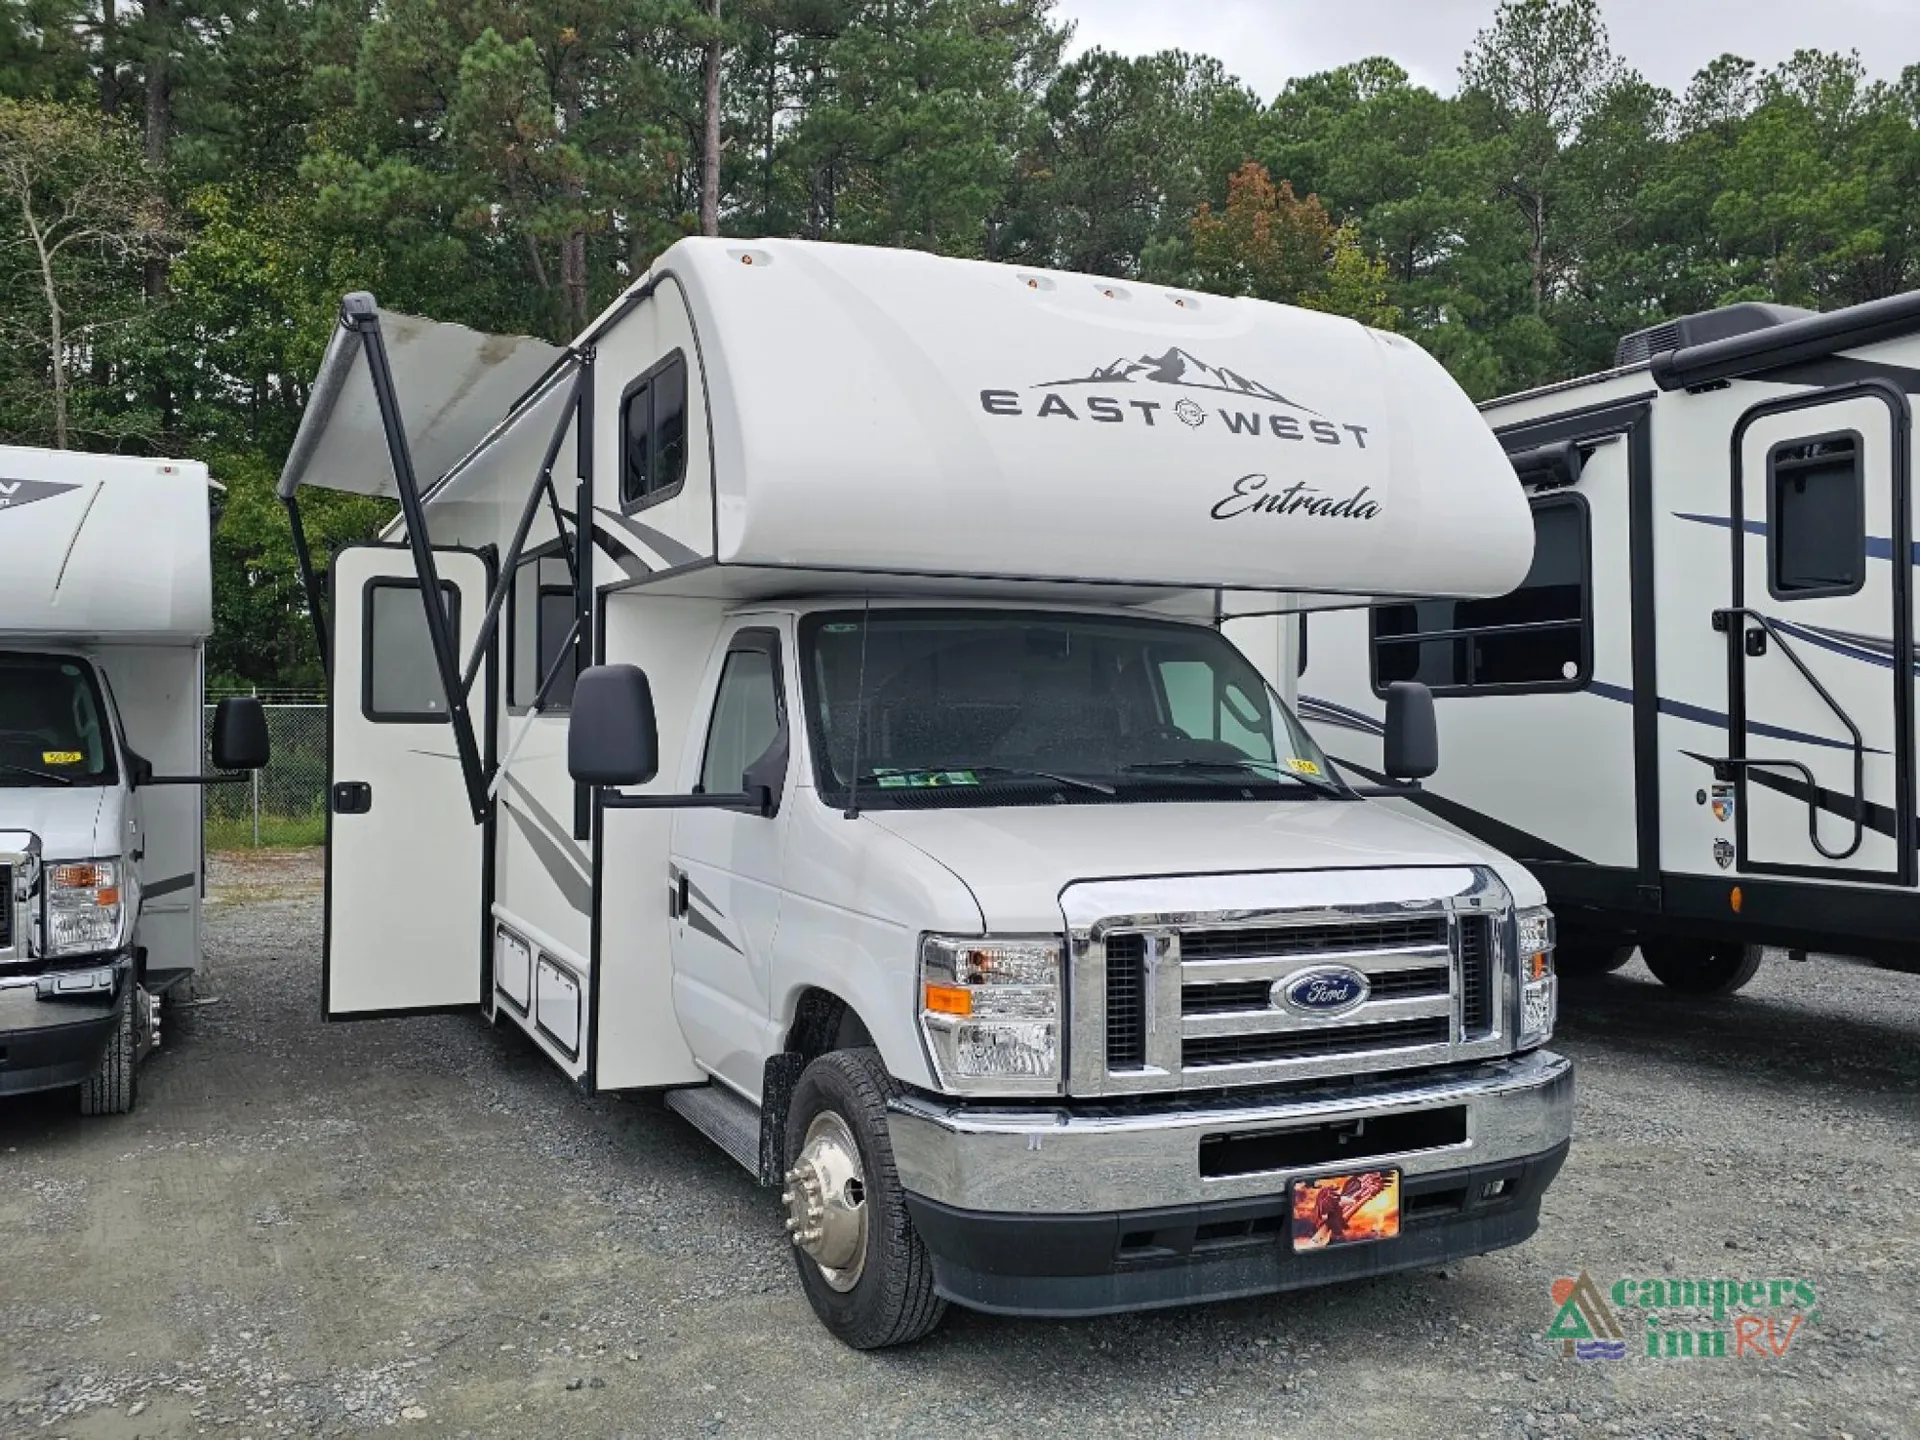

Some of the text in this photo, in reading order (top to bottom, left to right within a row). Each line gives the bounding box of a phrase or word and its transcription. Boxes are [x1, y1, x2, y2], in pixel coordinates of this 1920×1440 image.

[979, 388, 1162, 427] EAST
[1217, 406, 1369, 449] WEST
[1210, 473, 1383, 521] Entrada
[1306, 981, 1349, 1003] Ford
